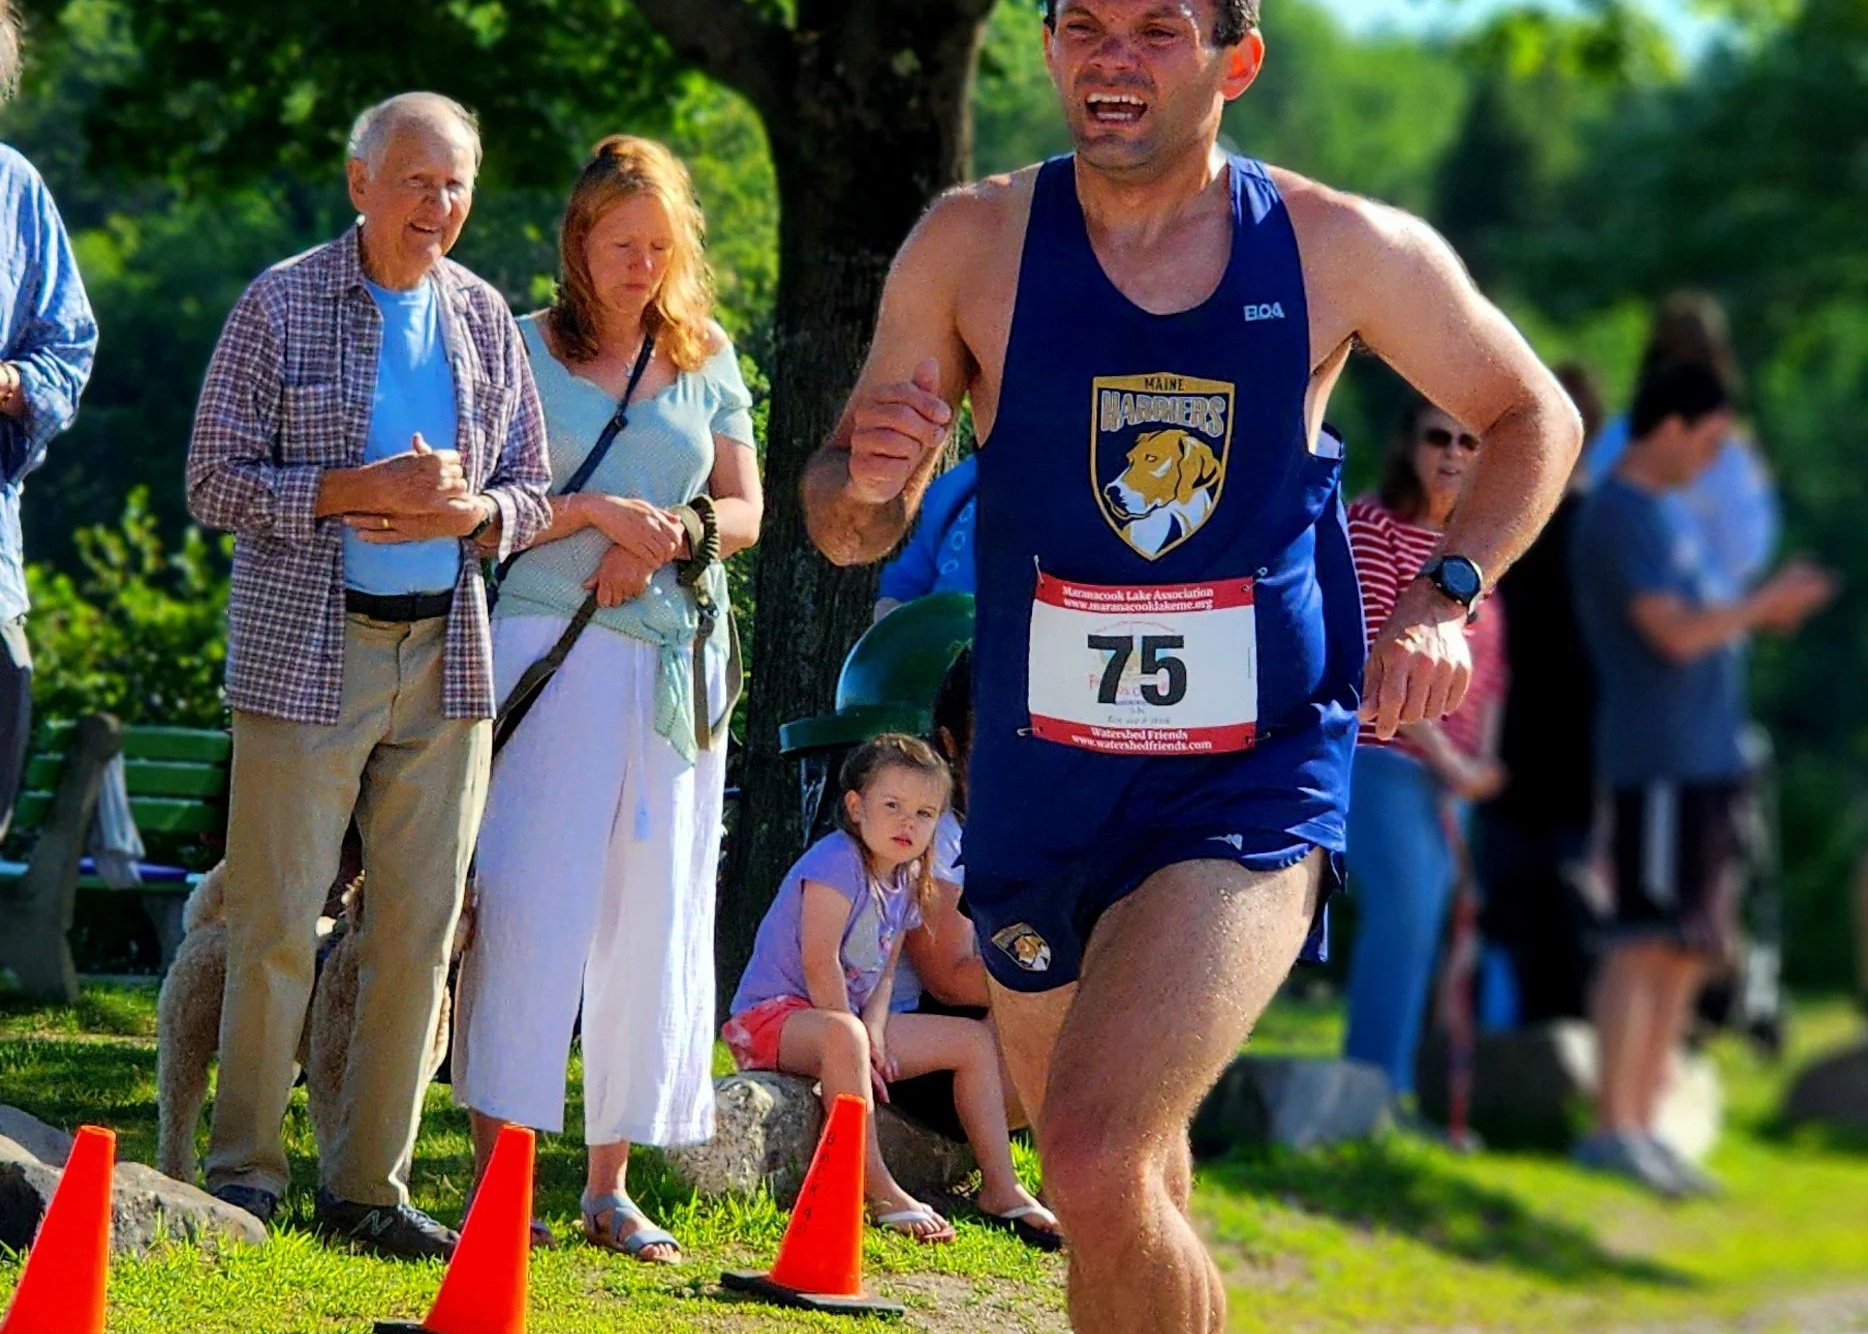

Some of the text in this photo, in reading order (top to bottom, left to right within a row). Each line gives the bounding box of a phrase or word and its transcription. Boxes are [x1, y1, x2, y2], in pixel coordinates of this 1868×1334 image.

[1144, 377, 1185, 391] MAINE
[1100, 390, 1226, 438] HARRIERS
[1062, 585, 1214, 601] Maranacook Lake Association
[1064, 598, 1213, 612] www.maranacooklakeme.org
[1088, 634, 1187, 706] 75
[1091, 727, 1188, 741] Watershed Friends
[1072, 735, 1212, 751] www.watershedfriends.com
